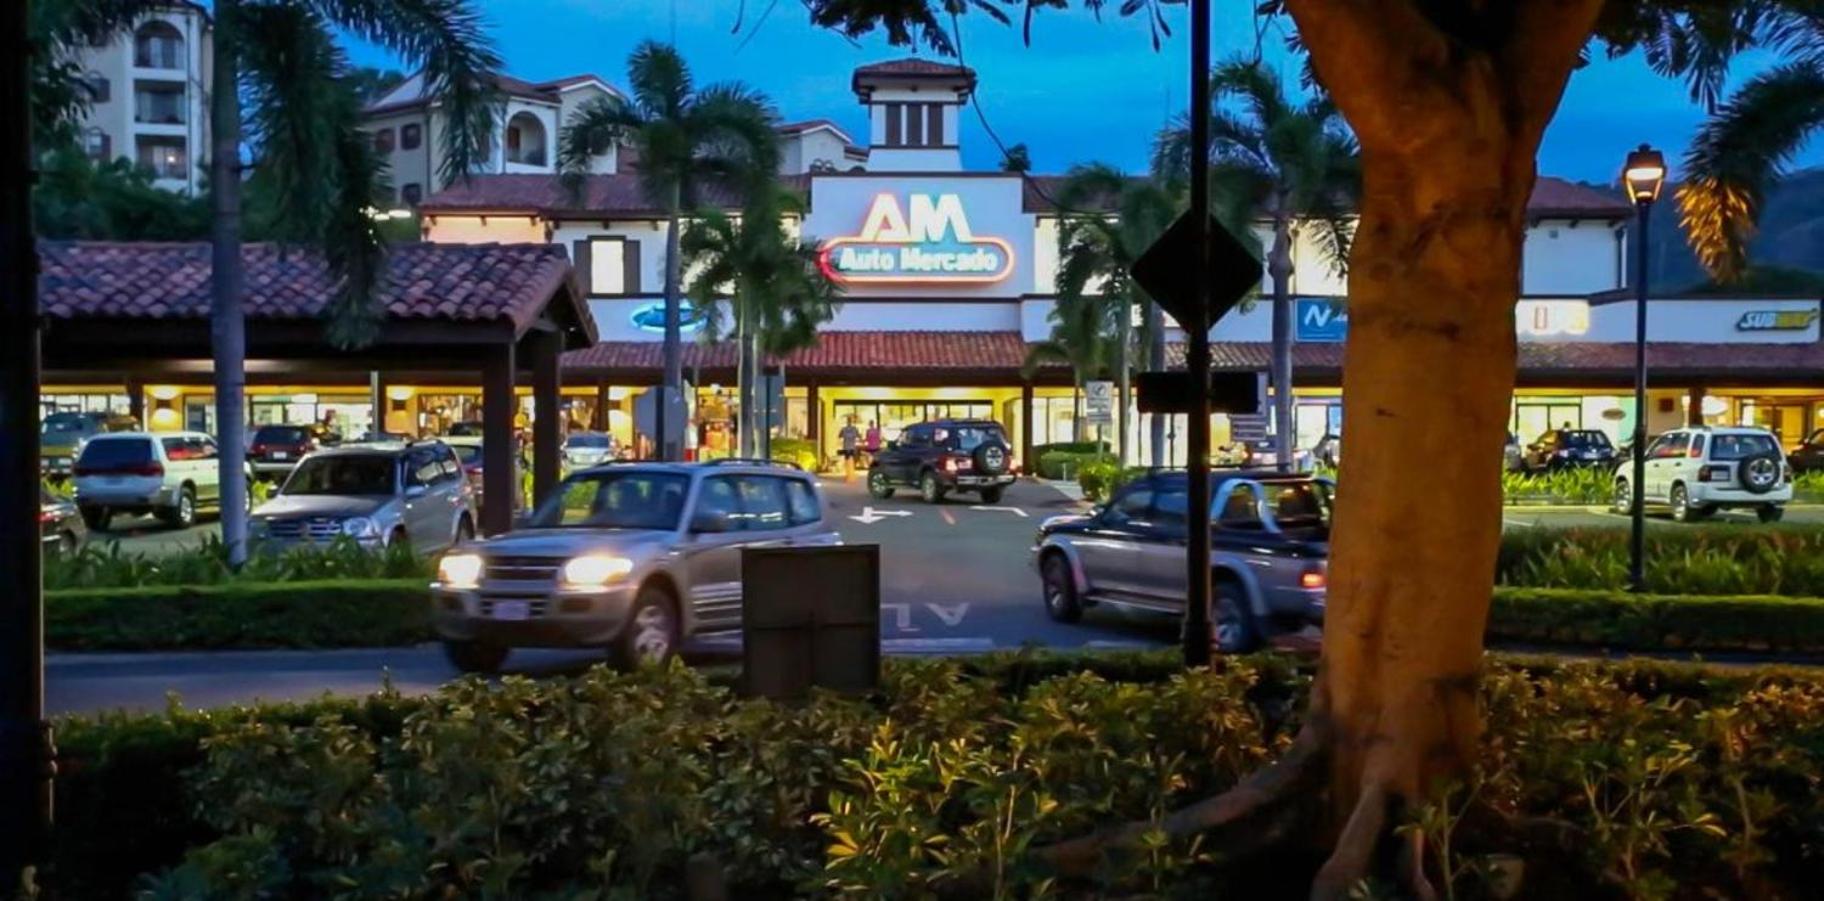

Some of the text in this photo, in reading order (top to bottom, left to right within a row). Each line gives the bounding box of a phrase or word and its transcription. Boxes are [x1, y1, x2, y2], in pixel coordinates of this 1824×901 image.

[861, 193, 972, 242] AM
[838, 247, 998, 272] Auto Mercado
